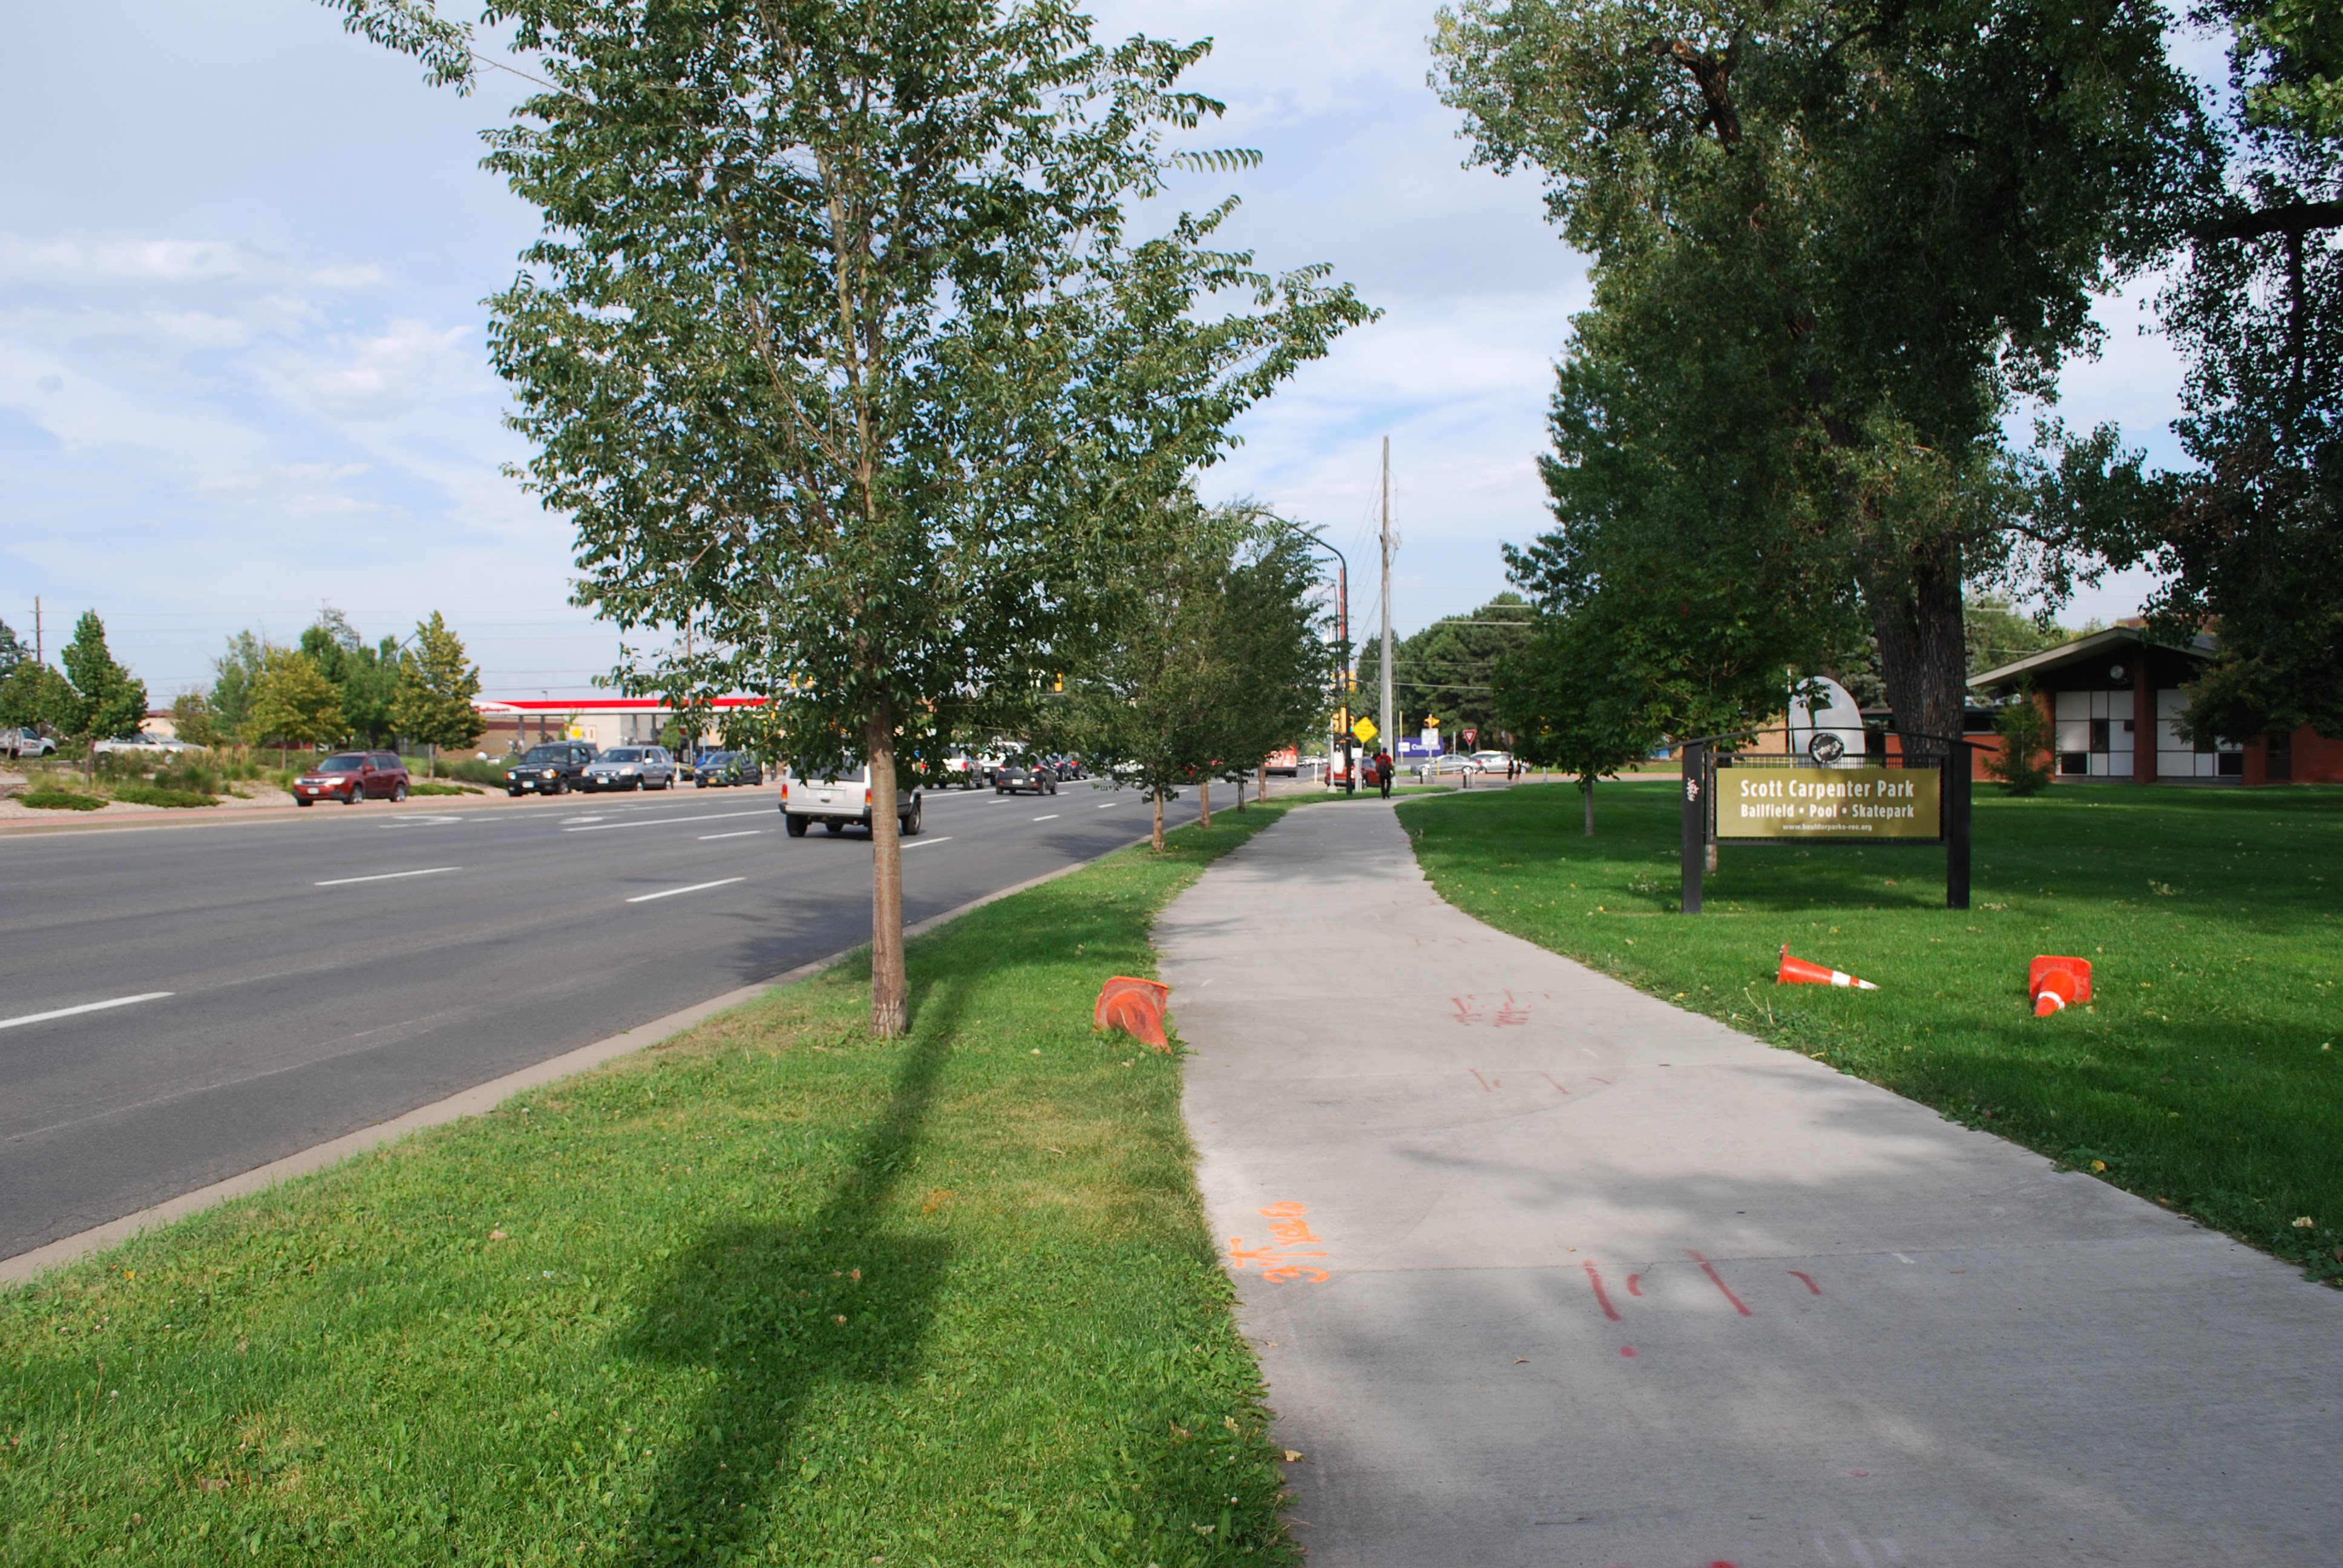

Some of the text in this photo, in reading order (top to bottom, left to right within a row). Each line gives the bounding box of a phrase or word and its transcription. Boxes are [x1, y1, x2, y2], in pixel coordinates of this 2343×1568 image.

[1740, 779, 1915, 800] Scott Carpenter Park
[1740, 803, 1915, 820] Ballfield Pool Skatepark
